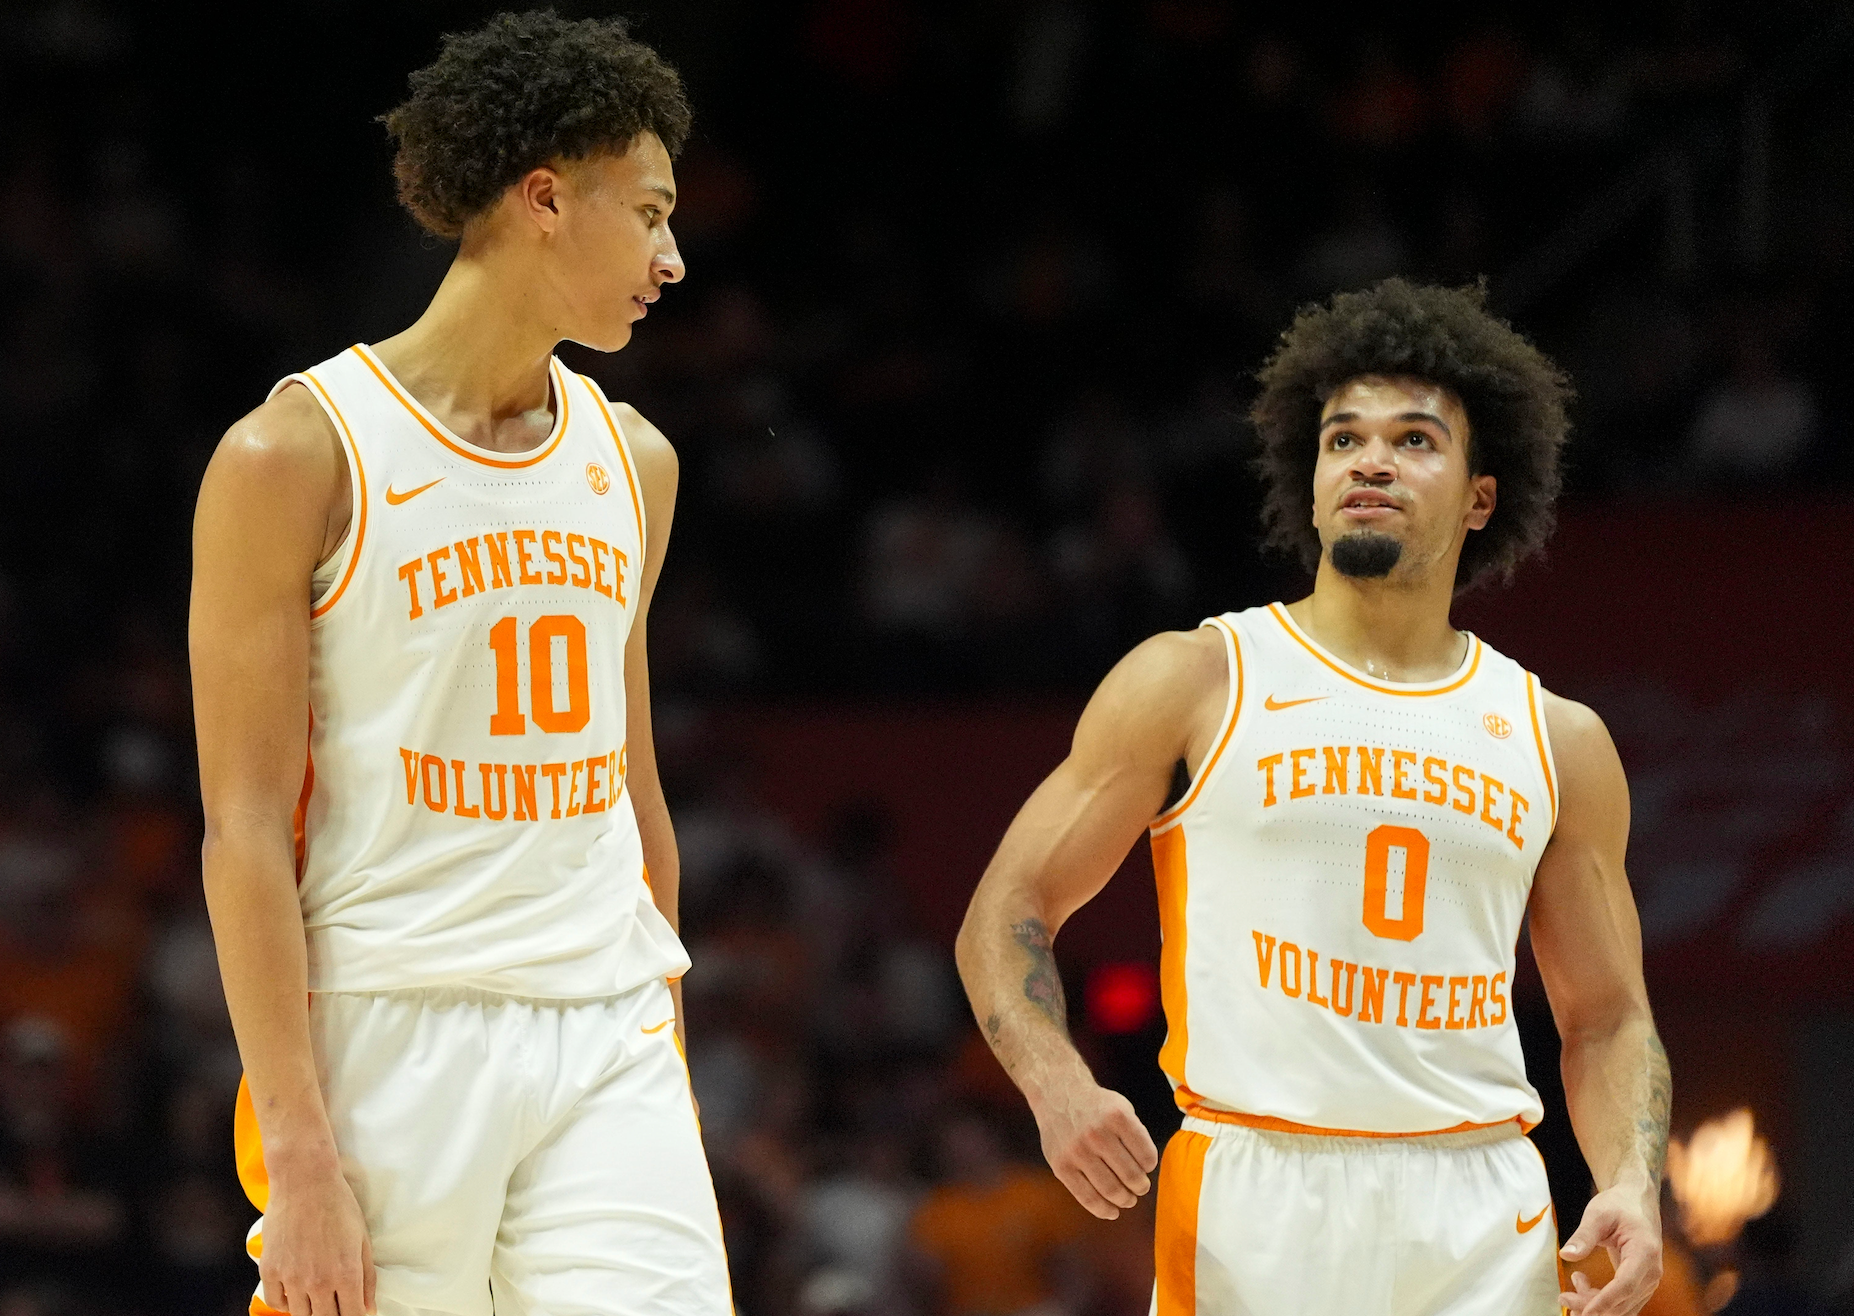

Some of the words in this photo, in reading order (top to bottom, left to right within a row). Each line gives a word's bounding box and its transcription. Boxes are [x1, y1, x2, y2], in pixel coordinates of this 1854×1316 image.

[588, 465, 608, 491] SEC
[398, 529, 628, 620] TENNESSEE
[489, 614, 591, 735] 10
[1486, 714, 1509, 736] SEC
[1257, 746, 1530, 851] TENNESSEE
[1362, 824, 1430, 942] 0
[1252, 930, 1507, 1030] VOLUNTEERS
